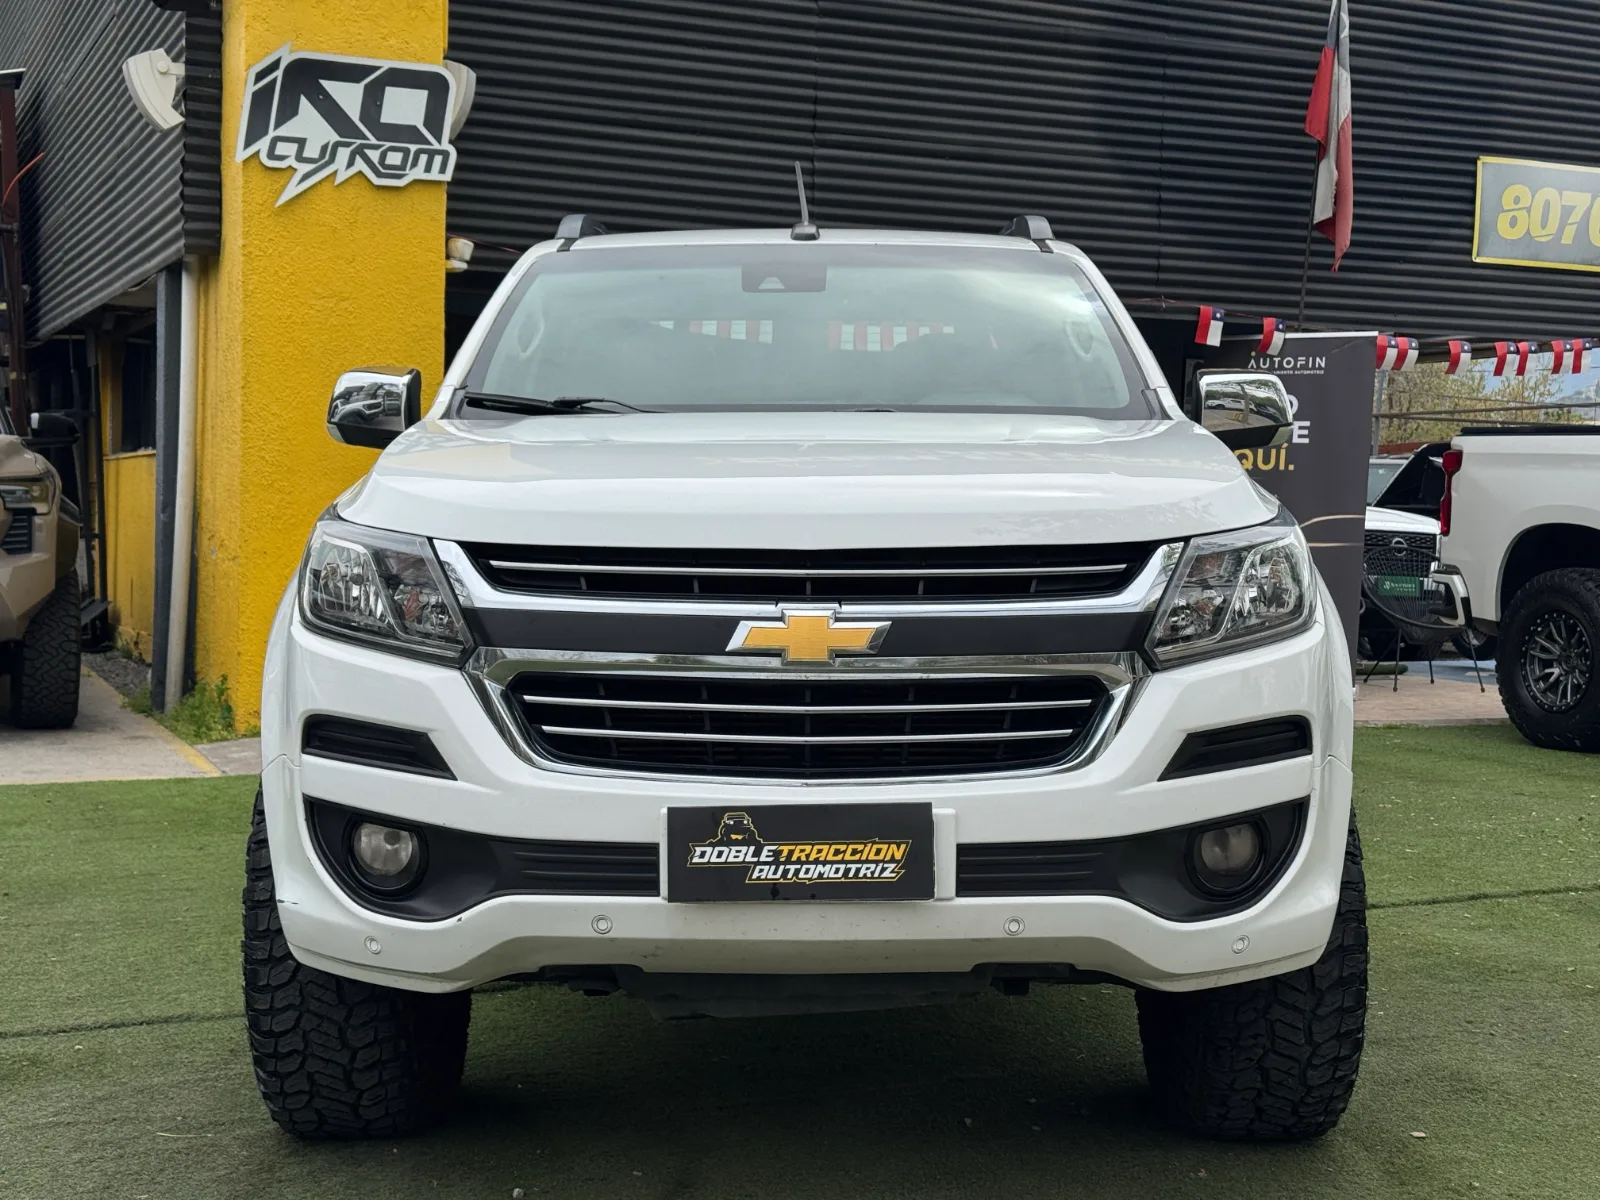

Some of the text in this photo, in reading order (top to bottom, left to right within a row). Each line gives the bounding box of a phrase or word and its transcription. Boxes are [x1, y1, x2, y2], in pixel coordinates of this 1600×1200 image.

[1248, 355, 1326, 369] AUTOFIN
[1233, 443, 1295, 471] QUÍ.
[751, 863, 898, 880] AUTOMOTRIZ
